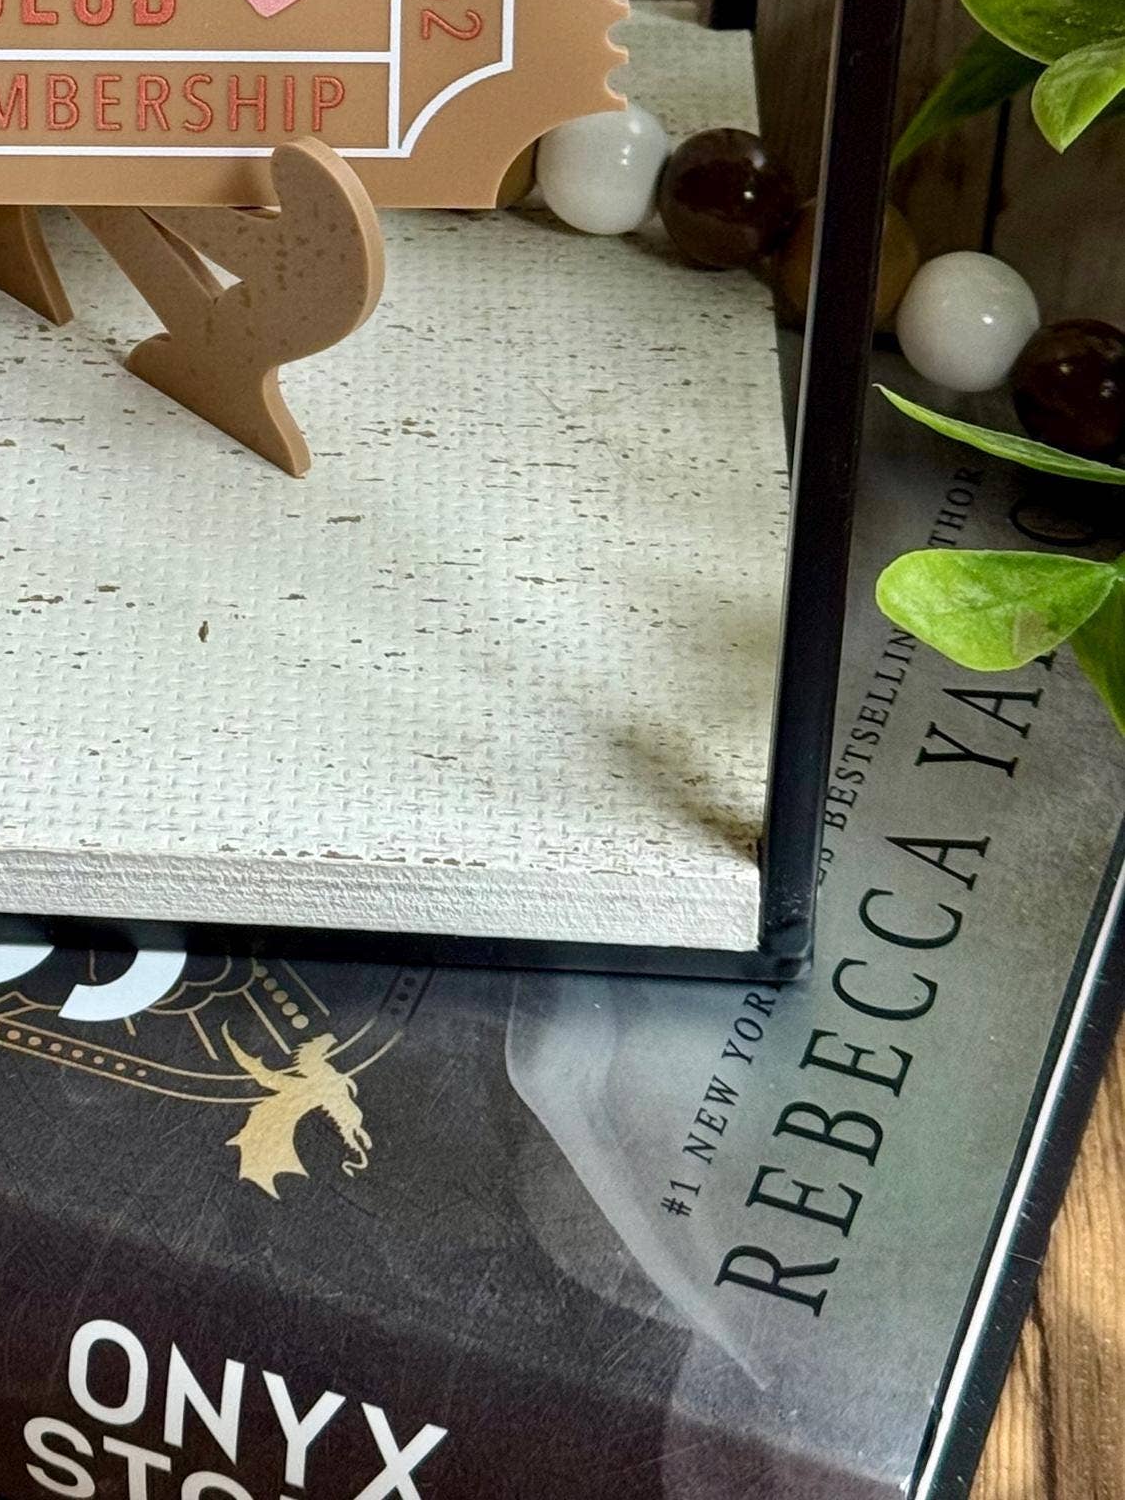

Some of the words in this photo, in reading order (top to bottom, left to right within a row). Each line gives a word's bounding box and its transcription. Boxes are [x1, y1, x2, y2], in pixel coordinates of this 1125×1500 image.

[659, 1179, 702, 1217] #1
[681, 1074, 740, 1166] NEW
[721, 985, 781, 1066] YOR
[823, 627, 918, 832] BESTSELLIN
[714, 835, 992, 1319] REBECCA
[68, 1318, 449, 1500] ONYX
